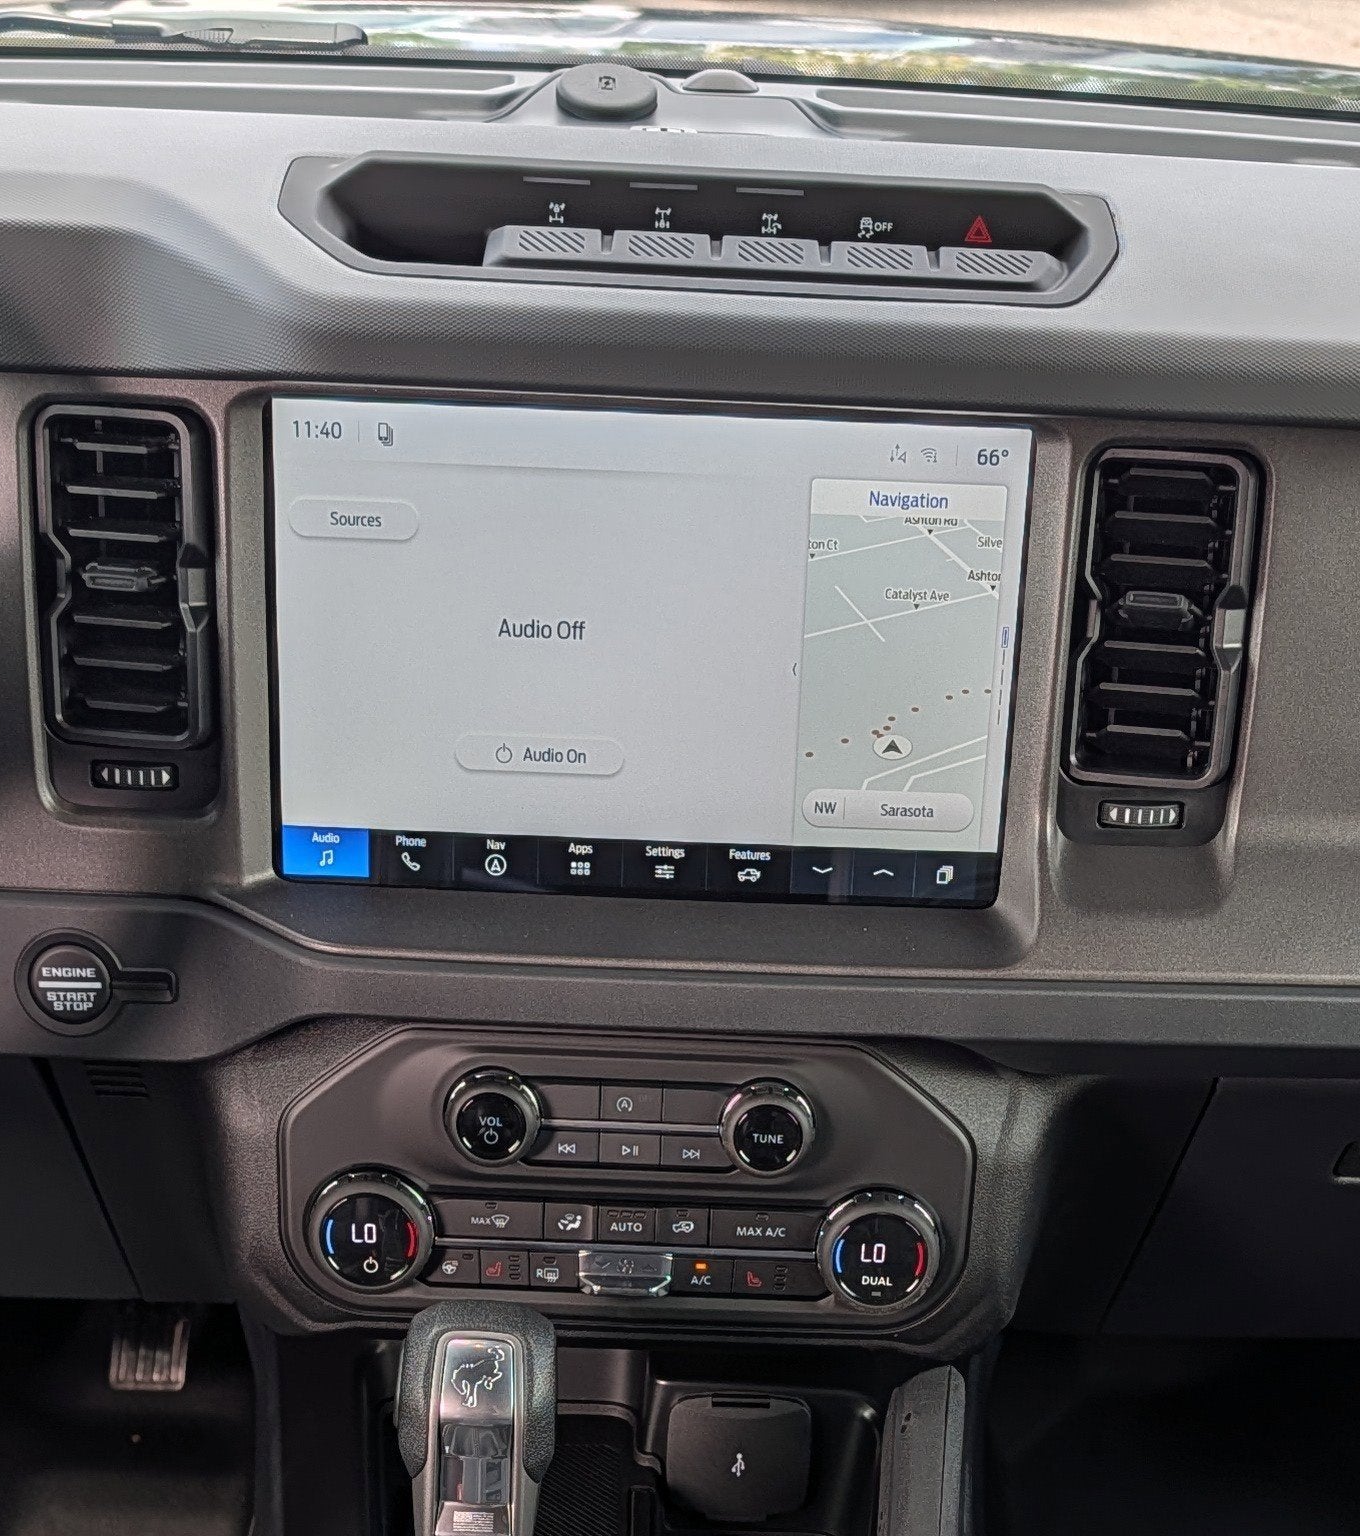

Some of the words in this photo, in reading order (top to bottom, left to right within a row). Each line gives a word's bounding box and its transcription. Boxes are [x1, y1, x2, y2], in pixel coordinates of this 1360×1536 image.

[874, 222, 894, 232] OFF
[292, 420, 342, 440] 11:40
[977, 448, 1009, 466] 66°
[869, 490, 949, 510] Navigation
[330, 511, 382, 528] Sources
[885, 588, 928, 602] Catalyst
[930, 590, 950, 602] Ave
[498, 618, 552, 639] Audio
[556, 620, 586, 640] Off
[522, 747, 564, 764] Audio
[566, 748, 587, 764] On
[814, 802, 837, 815] NW
[880, 804, 934, 818] Sarasota
[312, 832, 340, 844] Audio
[396, 836, 427, 848] Phone
[486, 839, 506, 850] Nav
[568, 842, 594, 856] Apps
[645, 846, 686, 860] Settings
[729, 849, 772, 861] Features
[42, 966, 96, 978] ENGINE
[46, 992, 97, 1002] START
[53, 1001, 94, 1011] STOP
[478, 1116, 504, 1128] VOL
[752, 1133, 784, 1145] TUNE
[470, 1216, 490, 1226] MAX
[351, 1223, 377, 1244] LO
[610, 1222, 643, 1233] AUTO
[736, 1226, 762, 1238] MAX
[764, 1226, 786, 1238] A/C
[861, 1244, 886, 1264] LO
[690, 1274, 712, 1286] A/C
[861, 1276, 893, 1287] DUAL
